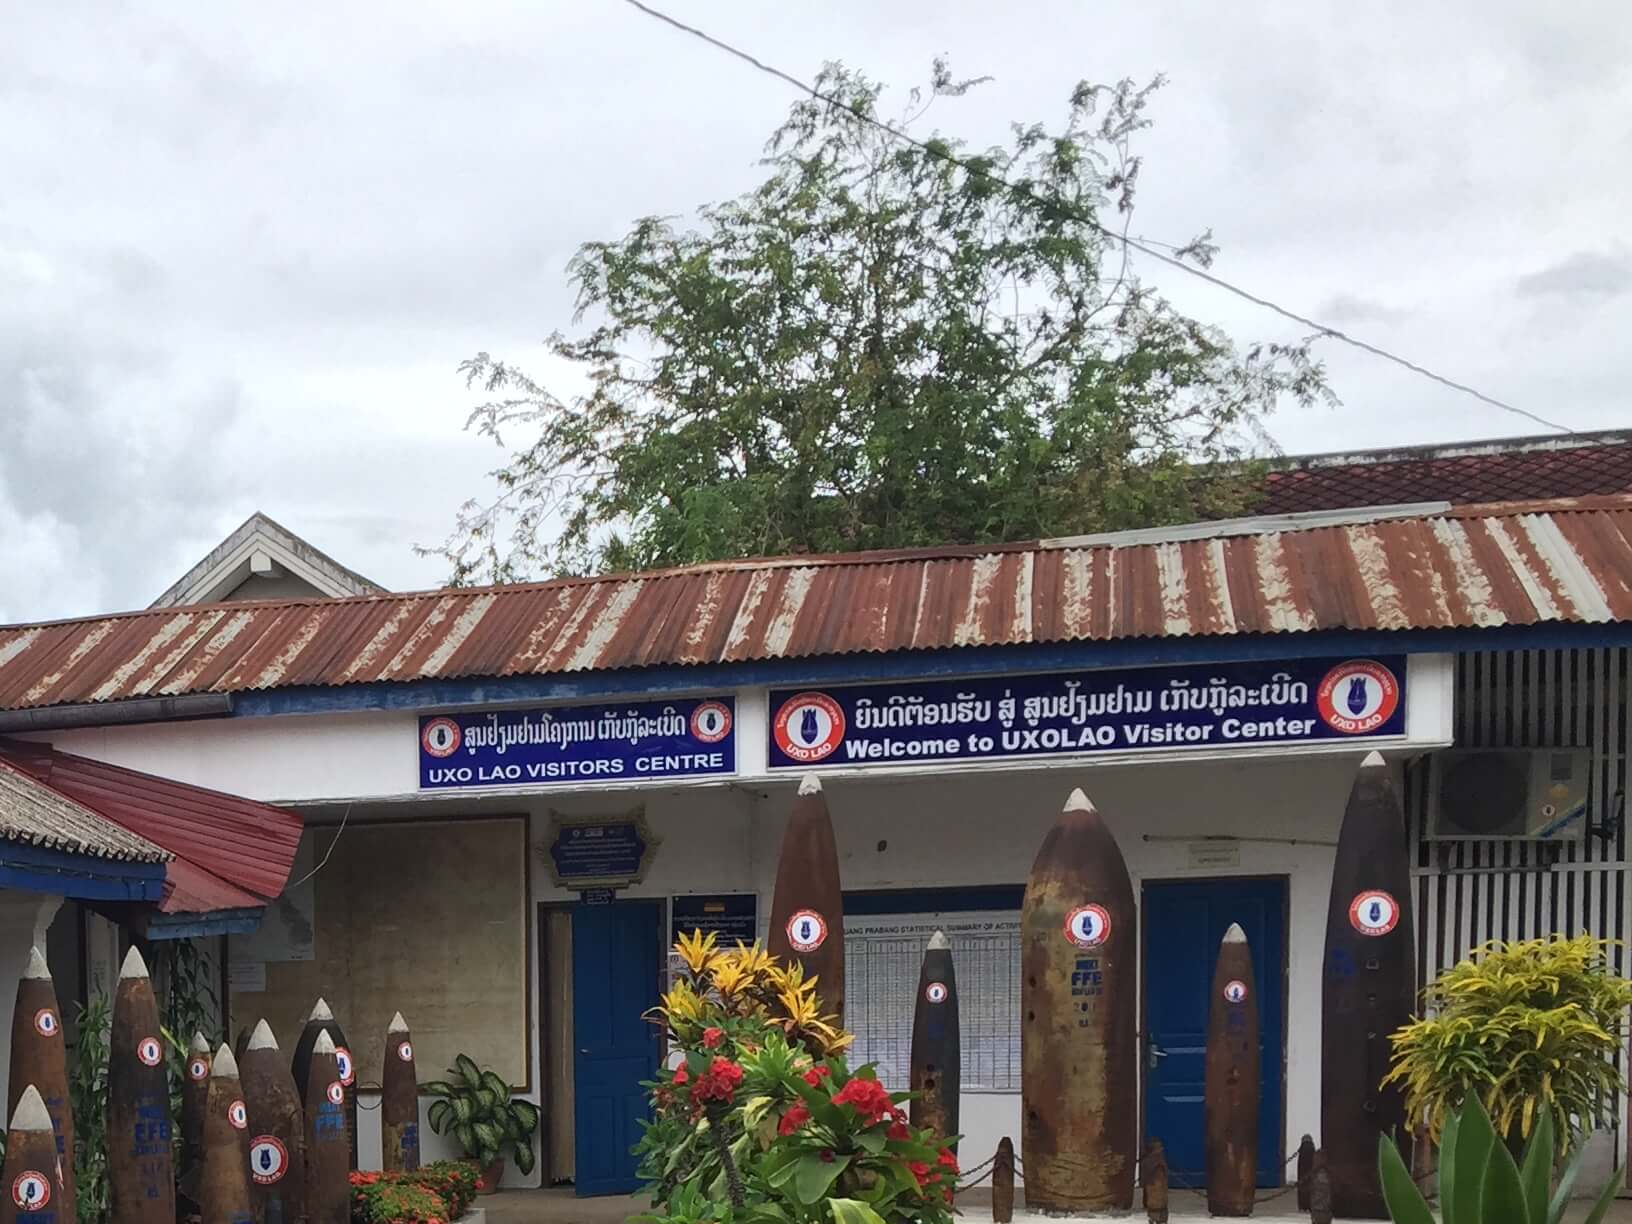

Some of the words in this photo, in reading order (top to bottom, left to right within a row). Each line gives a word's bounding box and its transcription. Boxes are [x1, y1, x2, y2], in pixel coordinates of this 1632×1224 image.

[786, 743, 809, 759] UXO
[810, 742, 832, 759] LAO
[845, 736, 960, 758] Welcome
[967, 733, 993, 752] to
[1002, 725, 1116, 750] UXOLAO
[1123, 721, 1214, 744] Visitor
[1222, 716, 1316, 738] Center
[429, 767, 472, 783] UXO
[478, 764, 521, 780] LAO
[526, 757, 625, 778] VISITORS
[635, 752, 724, 772] CENTRE
